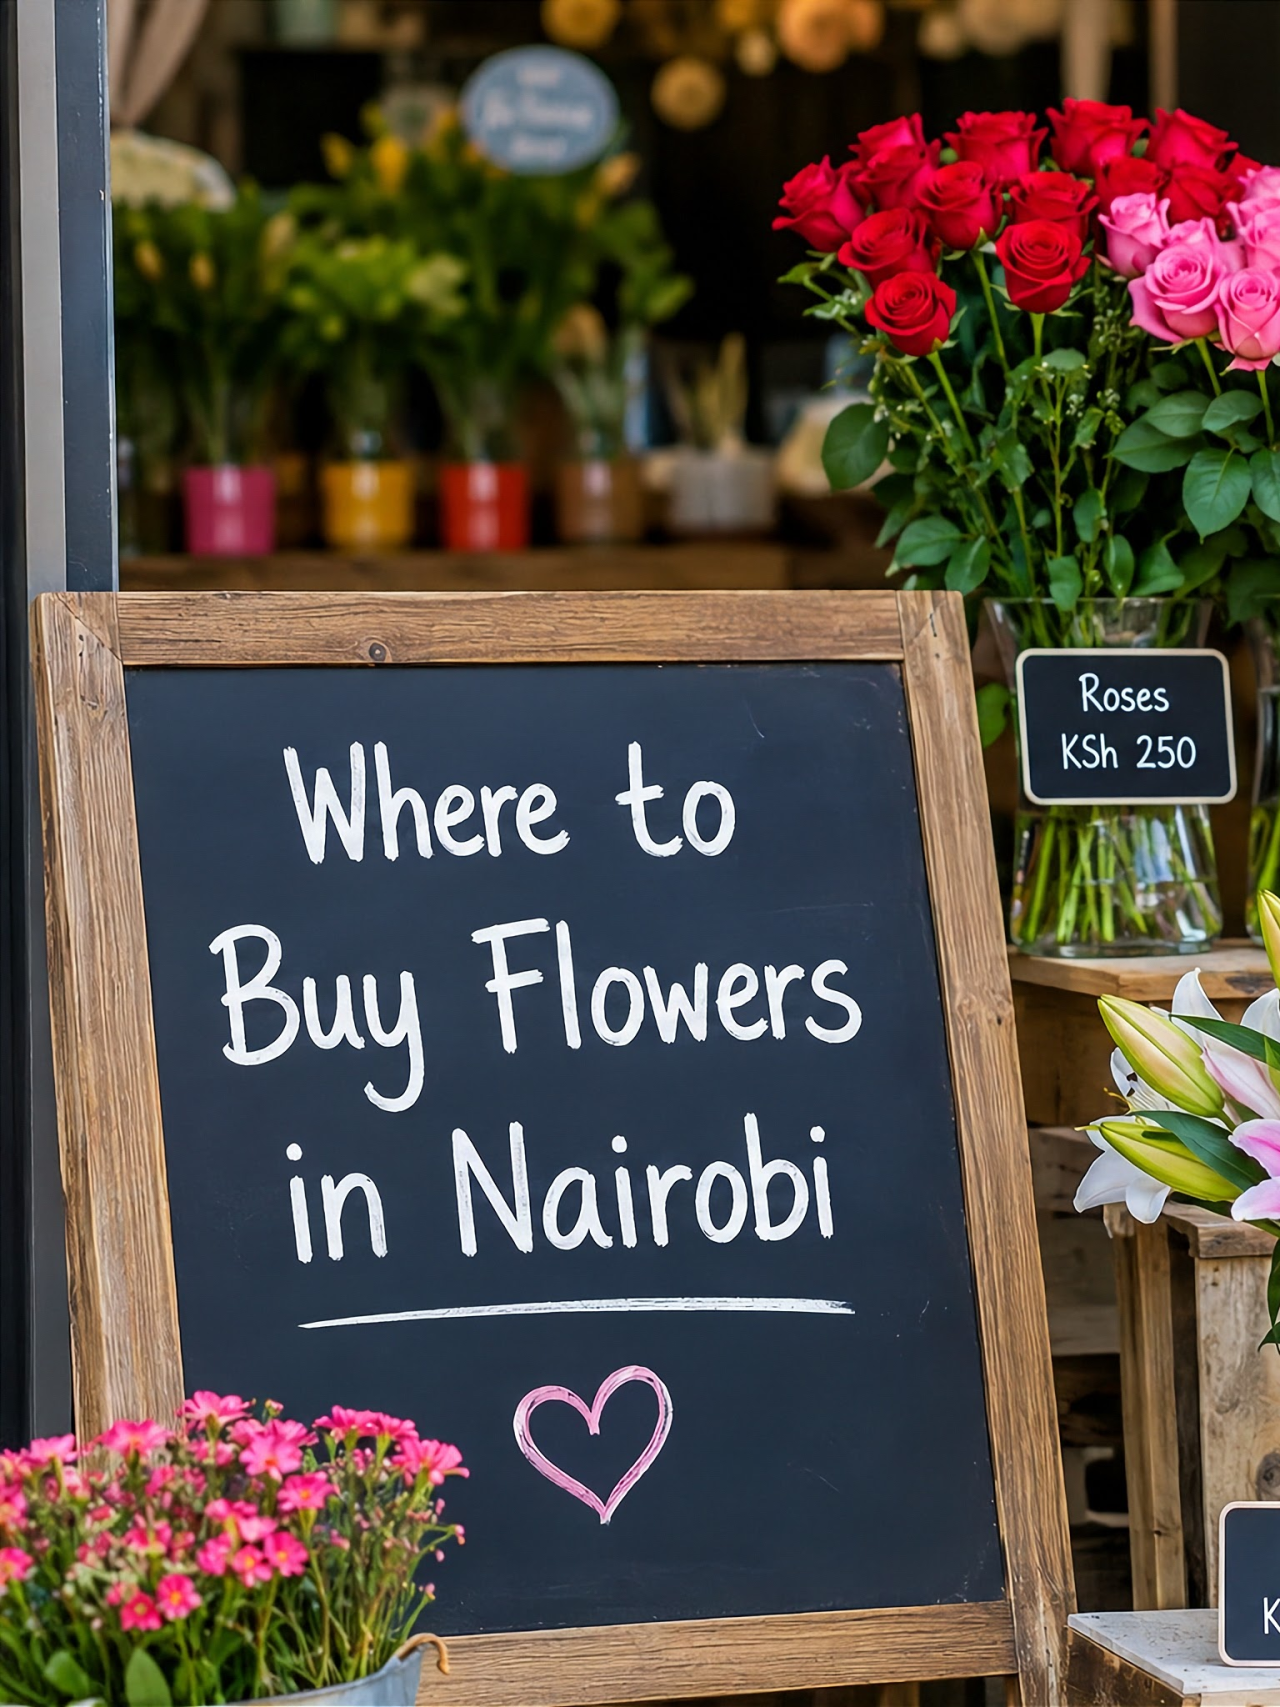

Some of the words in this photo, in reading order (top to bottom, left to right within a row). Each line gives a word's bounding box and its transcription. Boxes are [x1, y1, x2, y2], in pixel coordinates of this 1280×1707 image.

[1061, 733, 1119, 770] KSh
[1136, 734, 1197, 769] 250
[1078, 672, 1170, 712] Roses
[282, 740, 571, 865] Where
[614, 740, 736, 858] to
[208, 923, 425, 1113] Buy
[470, 917, 863, 1054] Flowers
[285, 1142, 389, 1264] in
[451, 1112, 834, 1258] Nairobi
